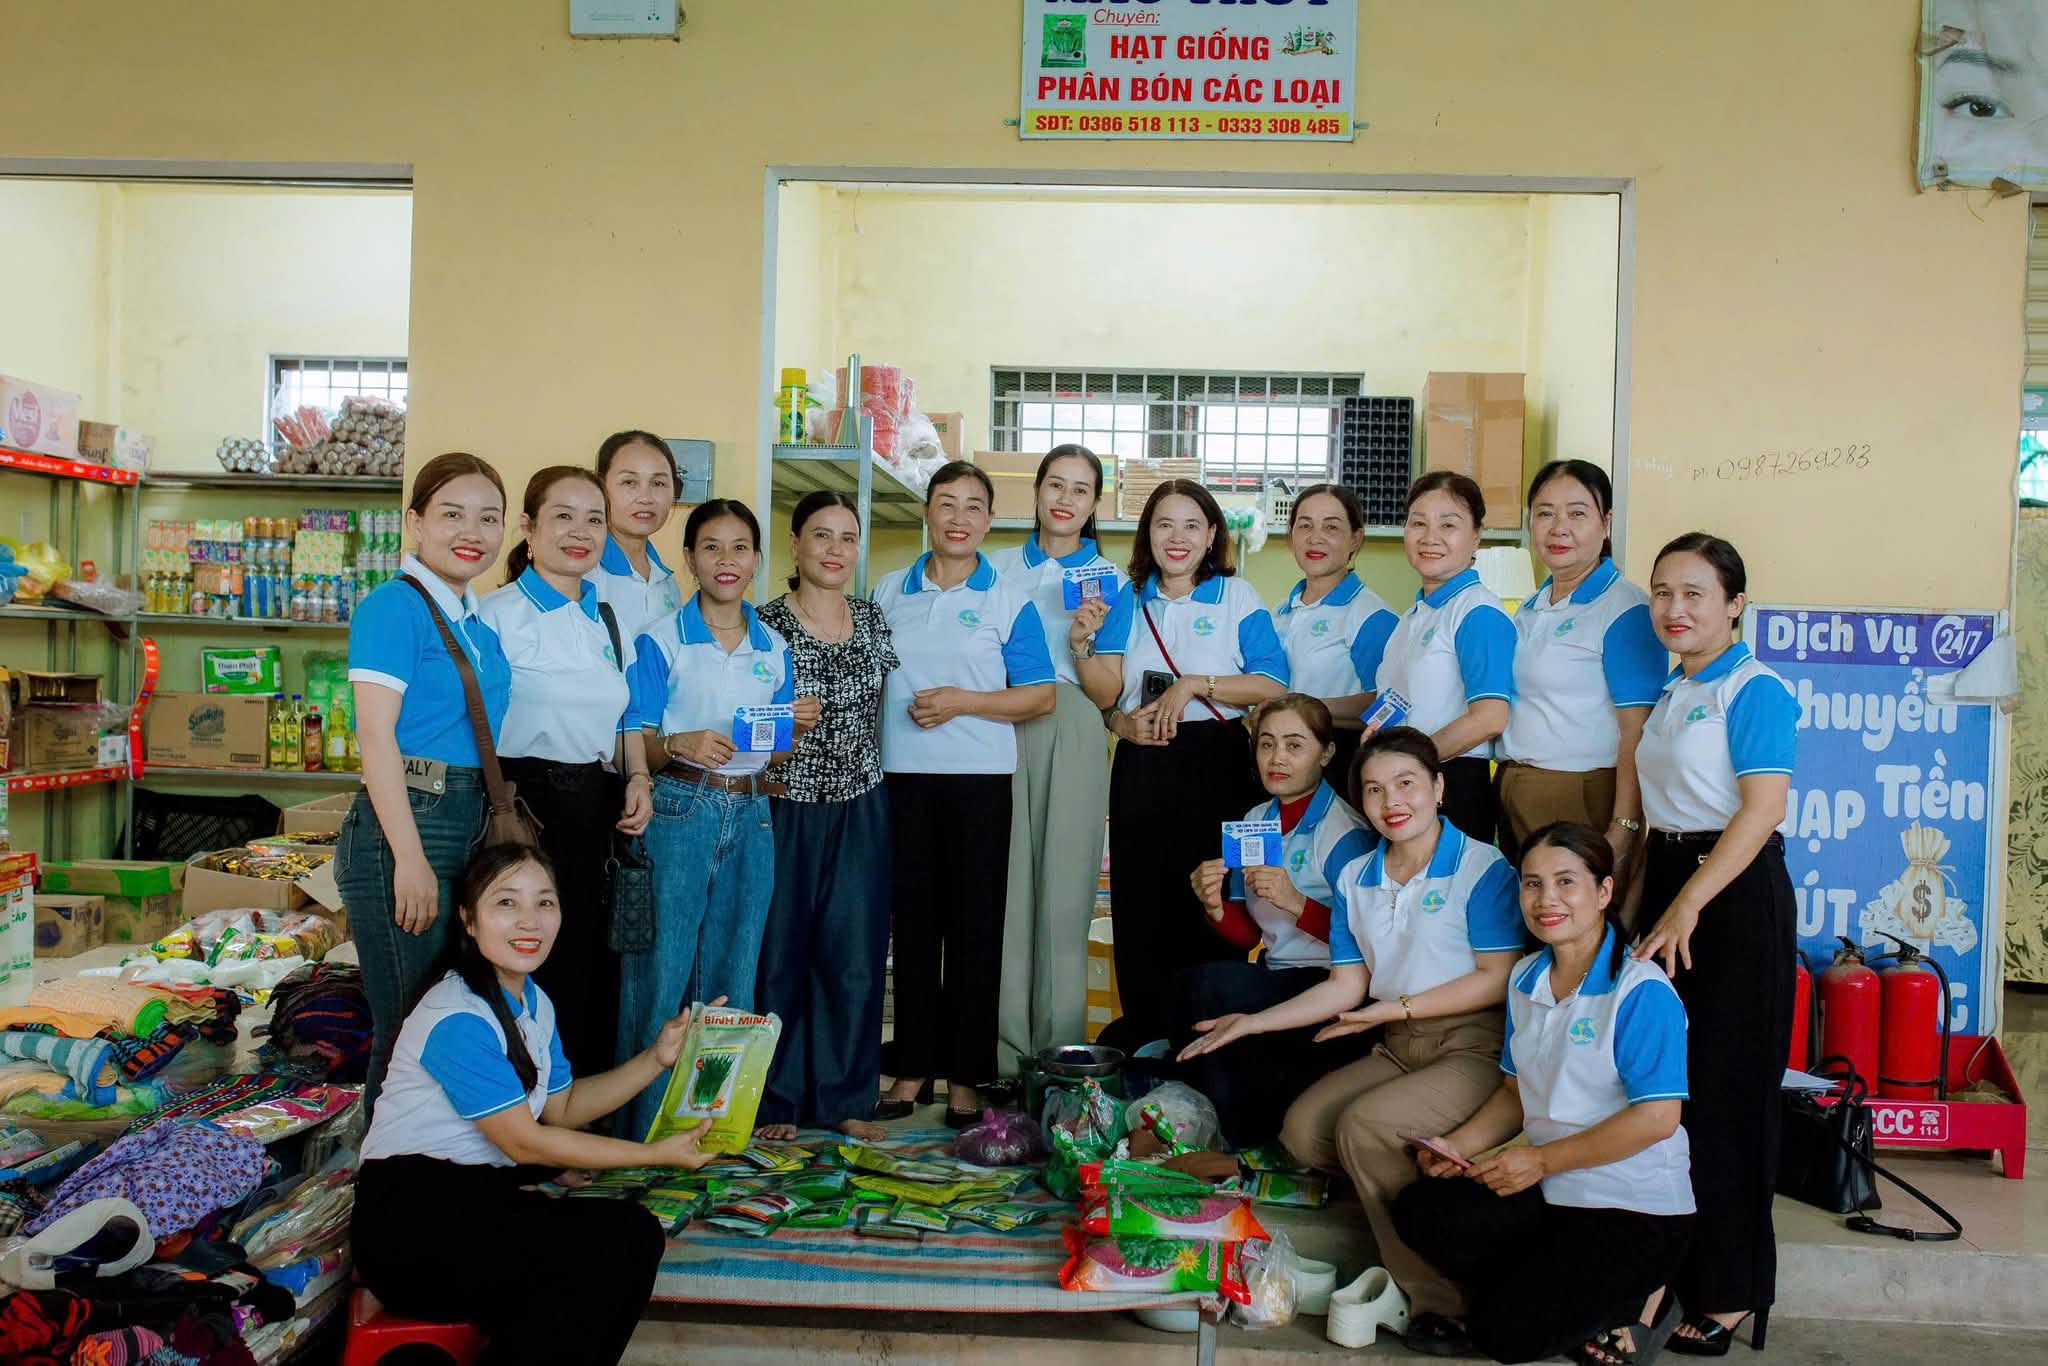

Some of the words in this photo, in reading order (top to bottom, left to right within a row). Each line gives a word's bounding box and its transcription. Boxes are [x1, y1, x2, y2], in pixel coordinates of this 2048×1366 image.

[1094, 9, 1160, 26] Chuyên:
[1110, 35, 1167, 64] HẠT
[1177, 27, 1270, 61] GIỐNG
[1038, 72, 1120, 101] PHÂN
[1131, 72, 1192, 102] BÓN
[1203, 73, 1263, 102] CÁC
[1273, 79, 1340, 109] LOẠI
[1079, 116, 1122, 132] 0386
[1128, 117, 1161, 132] 518
[1168, 117, 1199, 132] 113
[1218, 118, 1262, 133] 0333
[1268, 119, 1301, 134] 308
[1306, 119, 1340, 134] 485
[1767, 611, 1854, 660] Dịch
[1864, 618, 1918, 665] Vụ
[1939, 629, 1983, 659] 24/7
[1784, 668, 1958, 752] huyển
[403, 759, 433, 776] ALY
[1875, 748, 1985, 821] Tiền
[1794, 869, 1857, 937] ÚT
[1872, 1108, 1915, 1135] CC
[1919, 1126, 1940, 1137] 114
